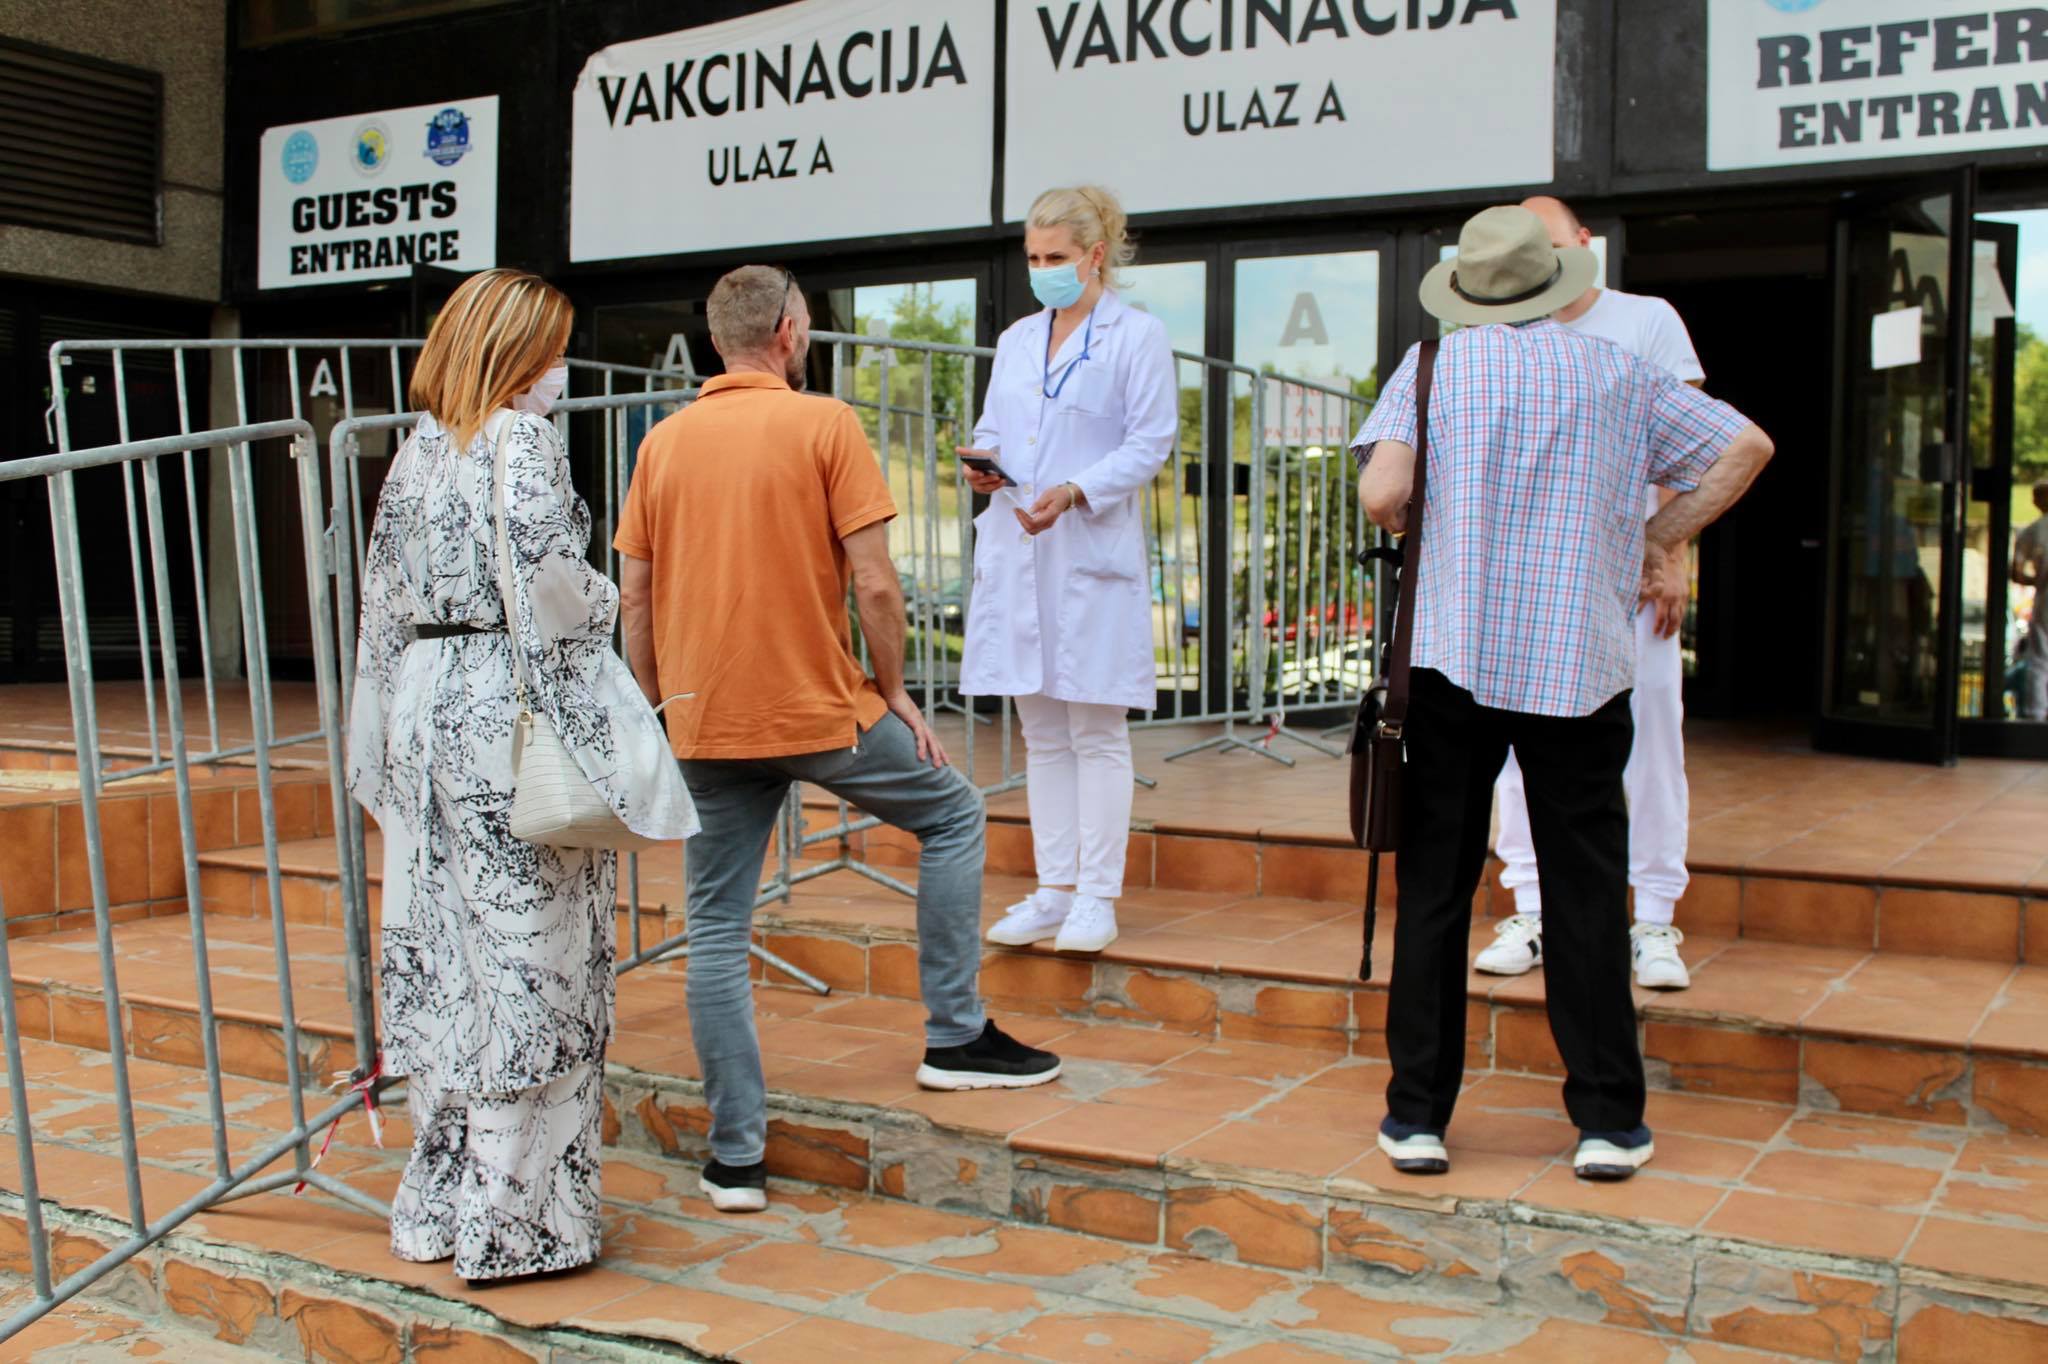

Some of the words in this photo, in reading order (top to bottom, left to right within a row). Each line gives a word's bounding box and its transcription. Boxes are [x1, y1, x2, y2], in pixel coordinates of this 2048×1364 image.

[1037, 0, 1519, 72] VAKCINAC
[598, 20, 968, 129] VAKCINACIJA
[1183, 83, 1301, 136] ULAZ
[1314, 79, 1347, 124] A
[708, 139, 798, 186] ULAZ
[809, 136, 834, 176] A
[292, 181, 457, 233] GUESTS
[290, 230, 460, 276] ENTRANCE
[1278, 292, 1329, 346] A
[310, 358, 338, 397] A
[660, 333, 698, 379] A
